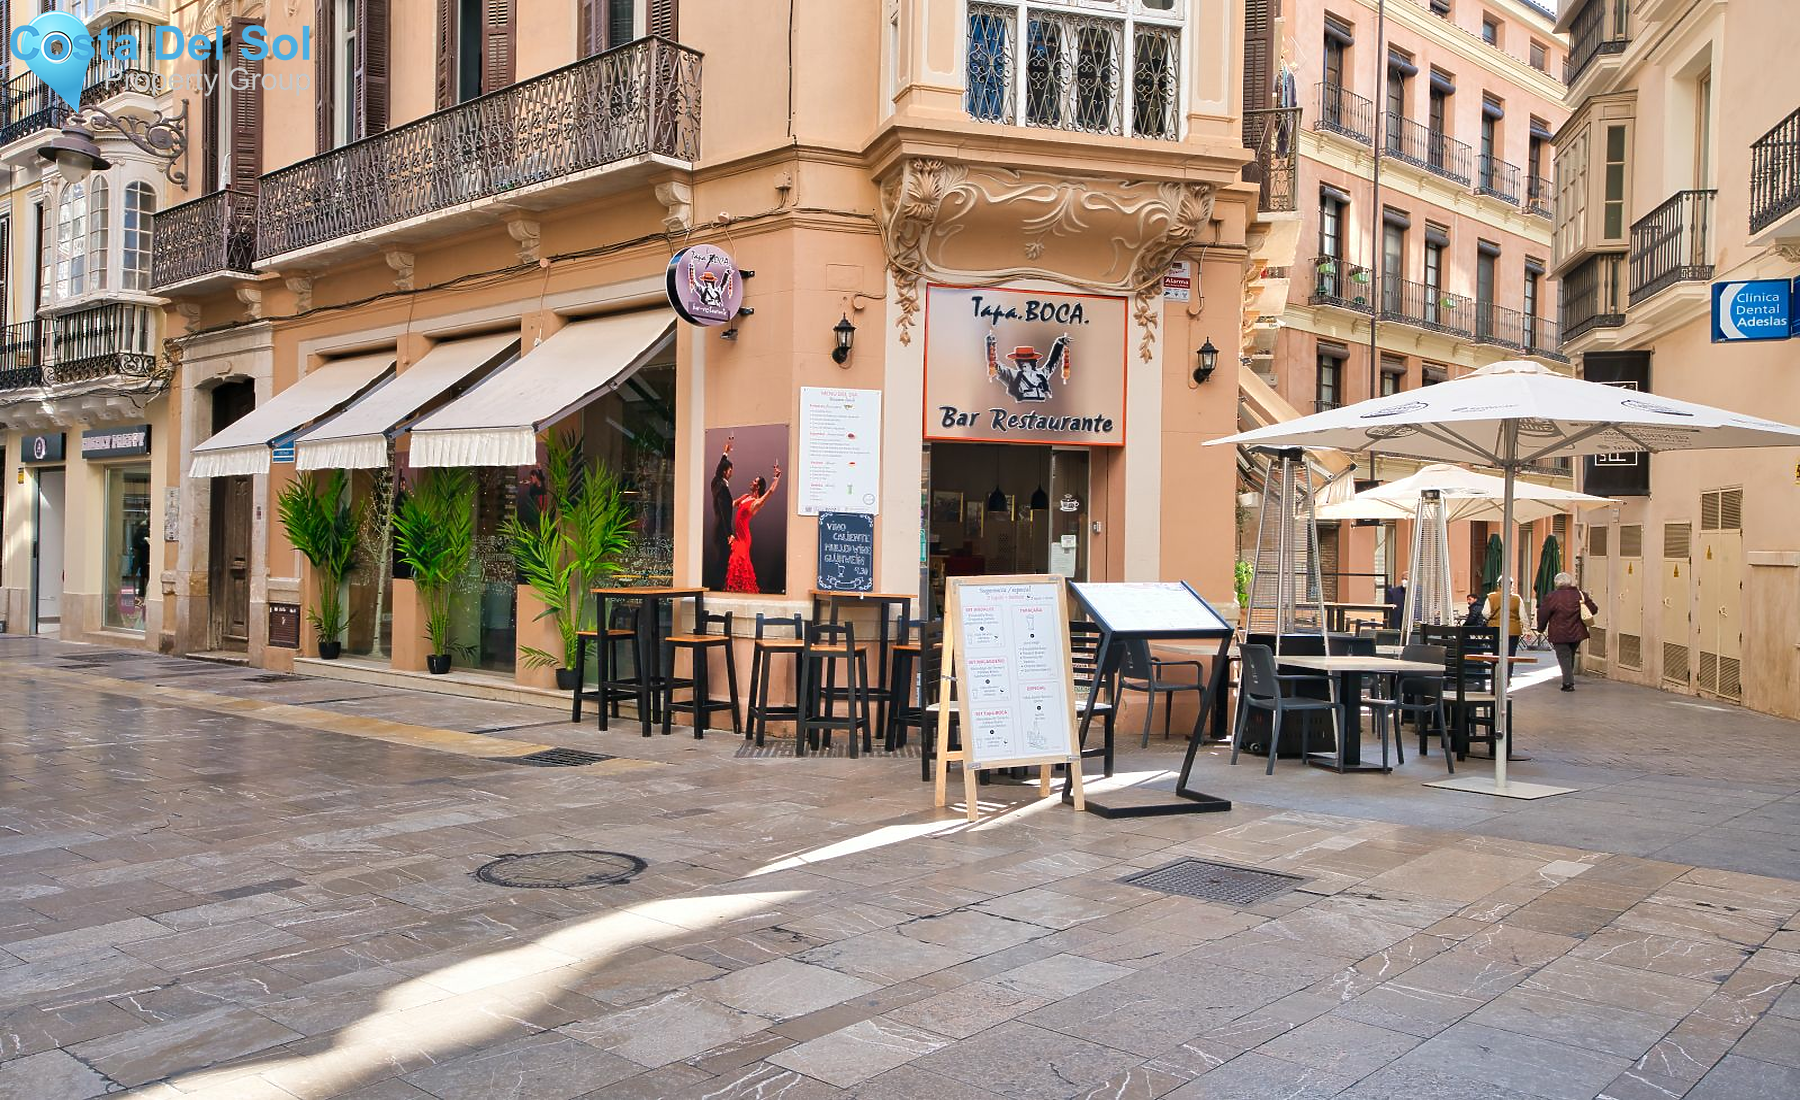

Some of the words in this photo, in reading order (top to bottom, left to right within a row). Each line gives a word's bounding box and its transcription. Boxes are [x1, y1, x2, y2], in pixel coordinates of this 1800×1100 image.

[1165, 277, 1189, 285] Alarma
[1736, 292, 1780, 303] Clínica
[1736, 304, 1780, 315] Dental
[1736, 316, 1788, 327] Adeslas
[939, 406, 980, 428] Bar
[989, 408, 1113, 433] Restaurante
